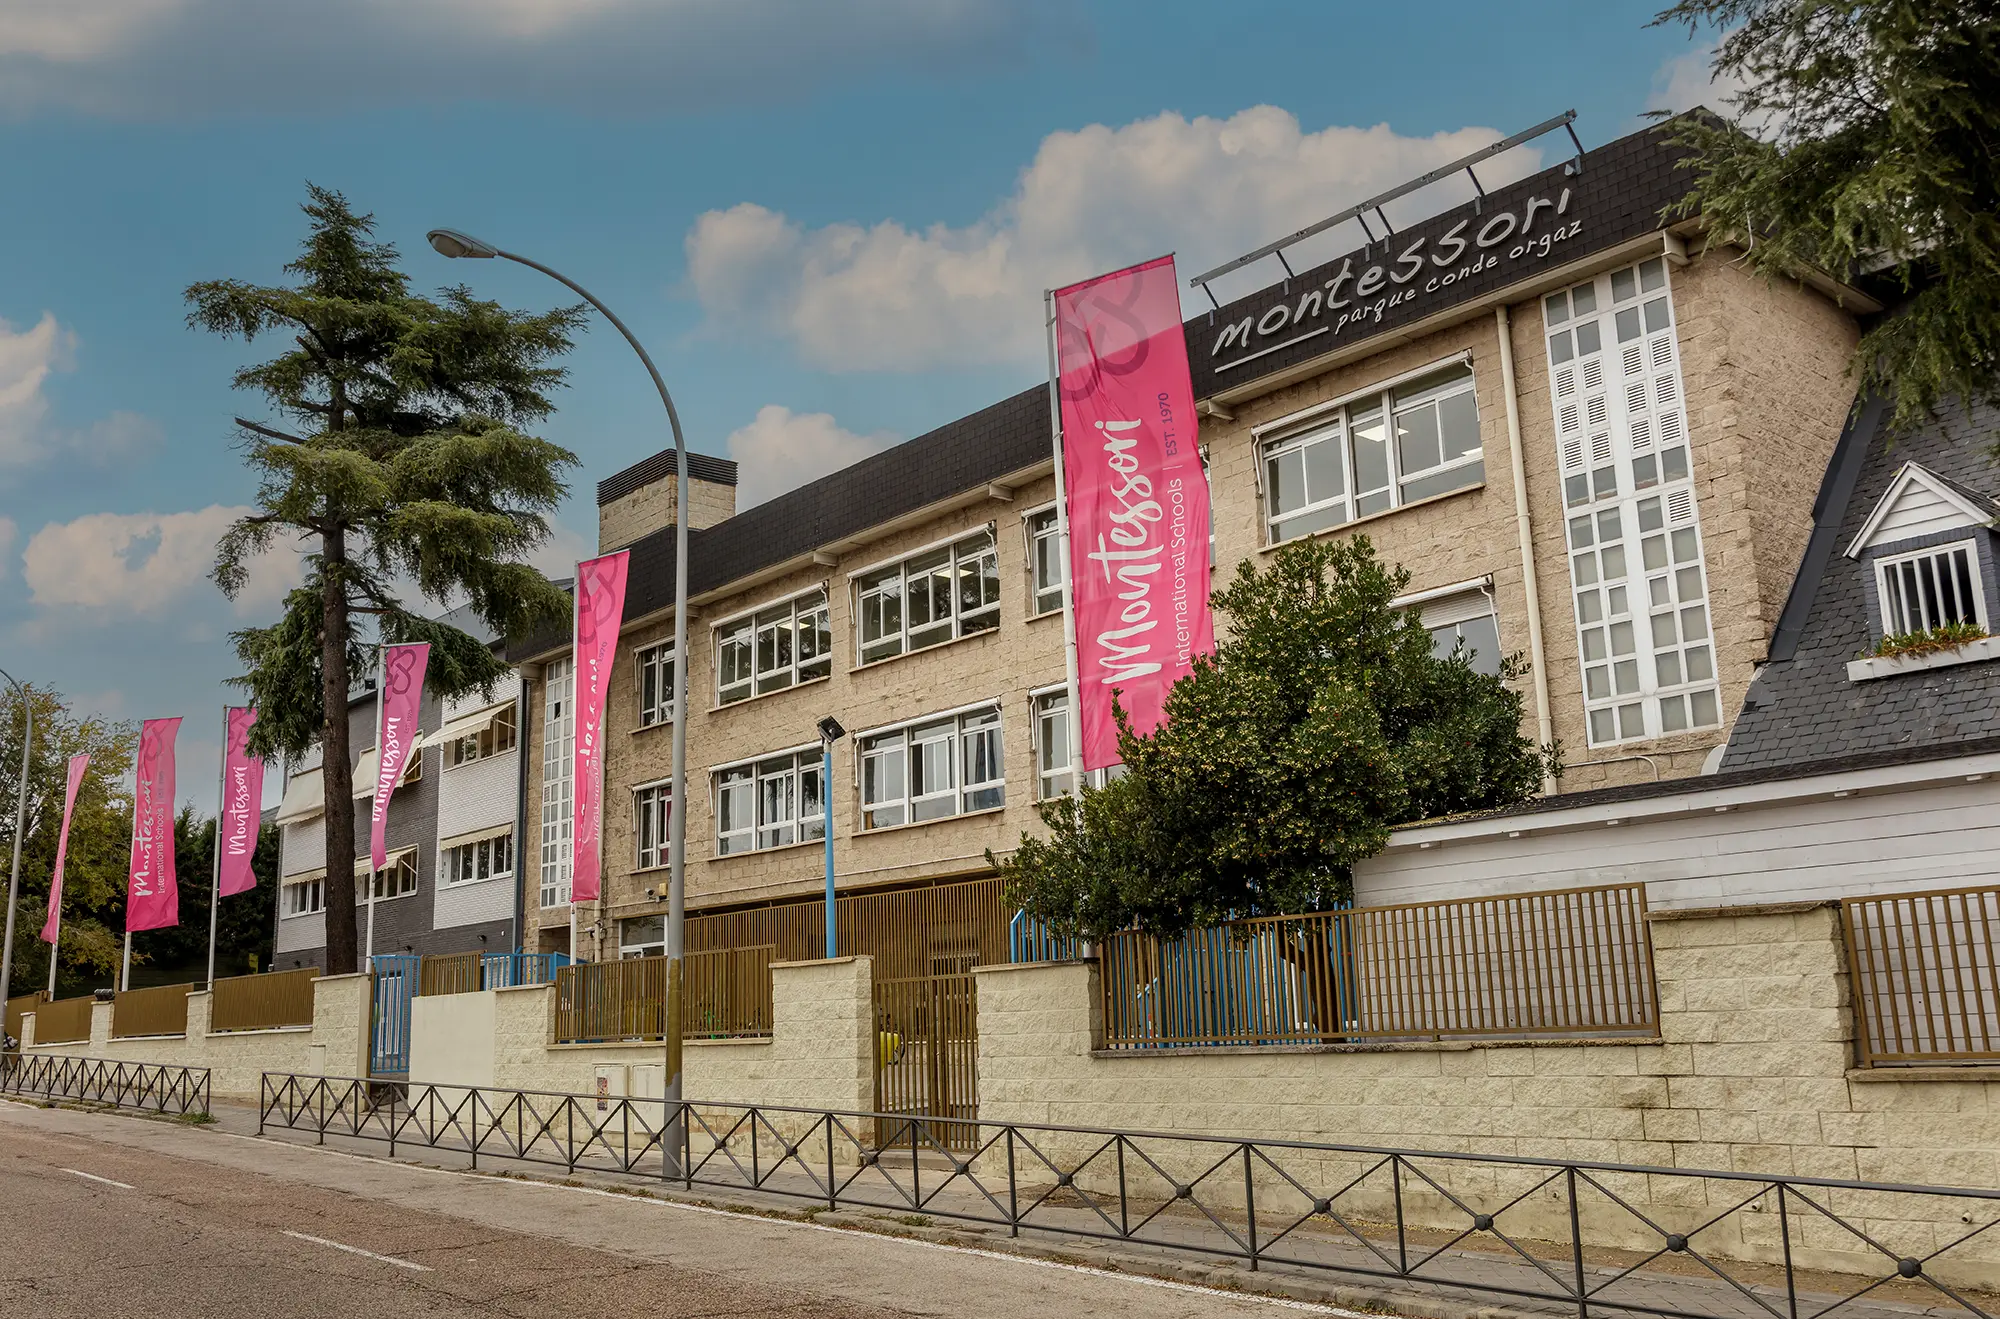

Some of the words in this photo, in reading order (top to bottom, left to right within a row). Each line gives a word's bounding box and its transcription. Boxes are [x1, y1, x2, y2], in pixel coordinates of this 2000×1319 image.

[1211, 187, 1573, 358] montessori
[1333, 289, 1417, 336] parque
[1425, 250, 1499, 293] conde
[1507, 217, 1584, 260] orgaz
[1157, 391, 1174, 425] 1970
[1163, 427, 1179, 458] EST.
[1087, 419, 1165, 686] Montessori
[1166, 477, 1187, 549] Schools
[1171, 550, 1191, 668] International
[154, 807, 166, 841] Schools
[228, 765, 250, 856] Montessori
[155, 841, 166, 895] International
